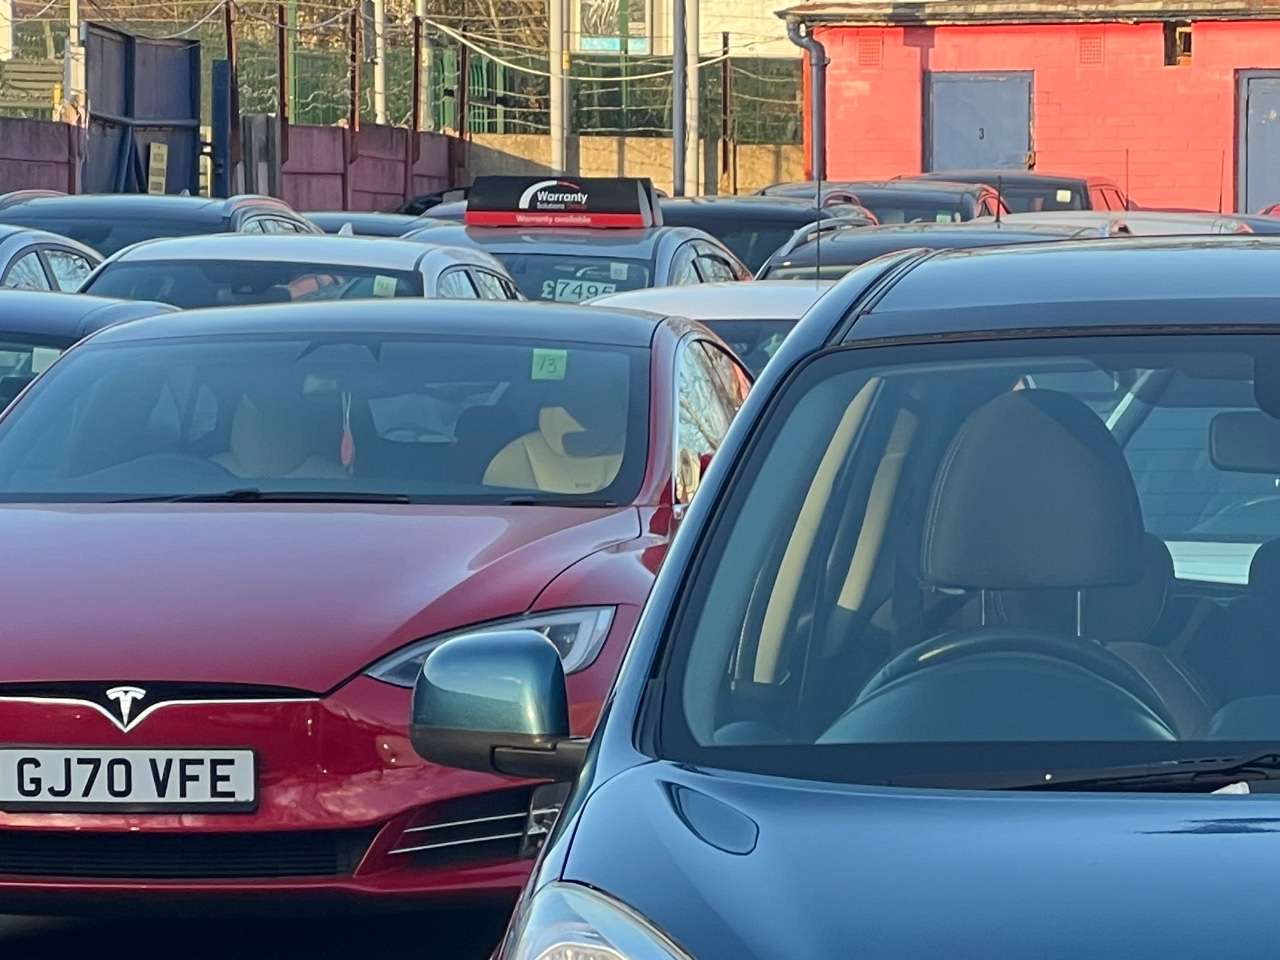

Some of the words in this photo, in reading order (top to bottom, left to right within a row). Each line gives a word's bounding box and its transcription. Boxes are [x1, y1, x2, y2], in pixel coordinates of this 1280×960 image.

[978, 127, 985, 140] 3
[537, 191, 588, 205] Warranty
[516, 215, 553, 225] Warranty
[17, 757, 132, 798] GJ70
[149, 758, 236, 798] VFE
